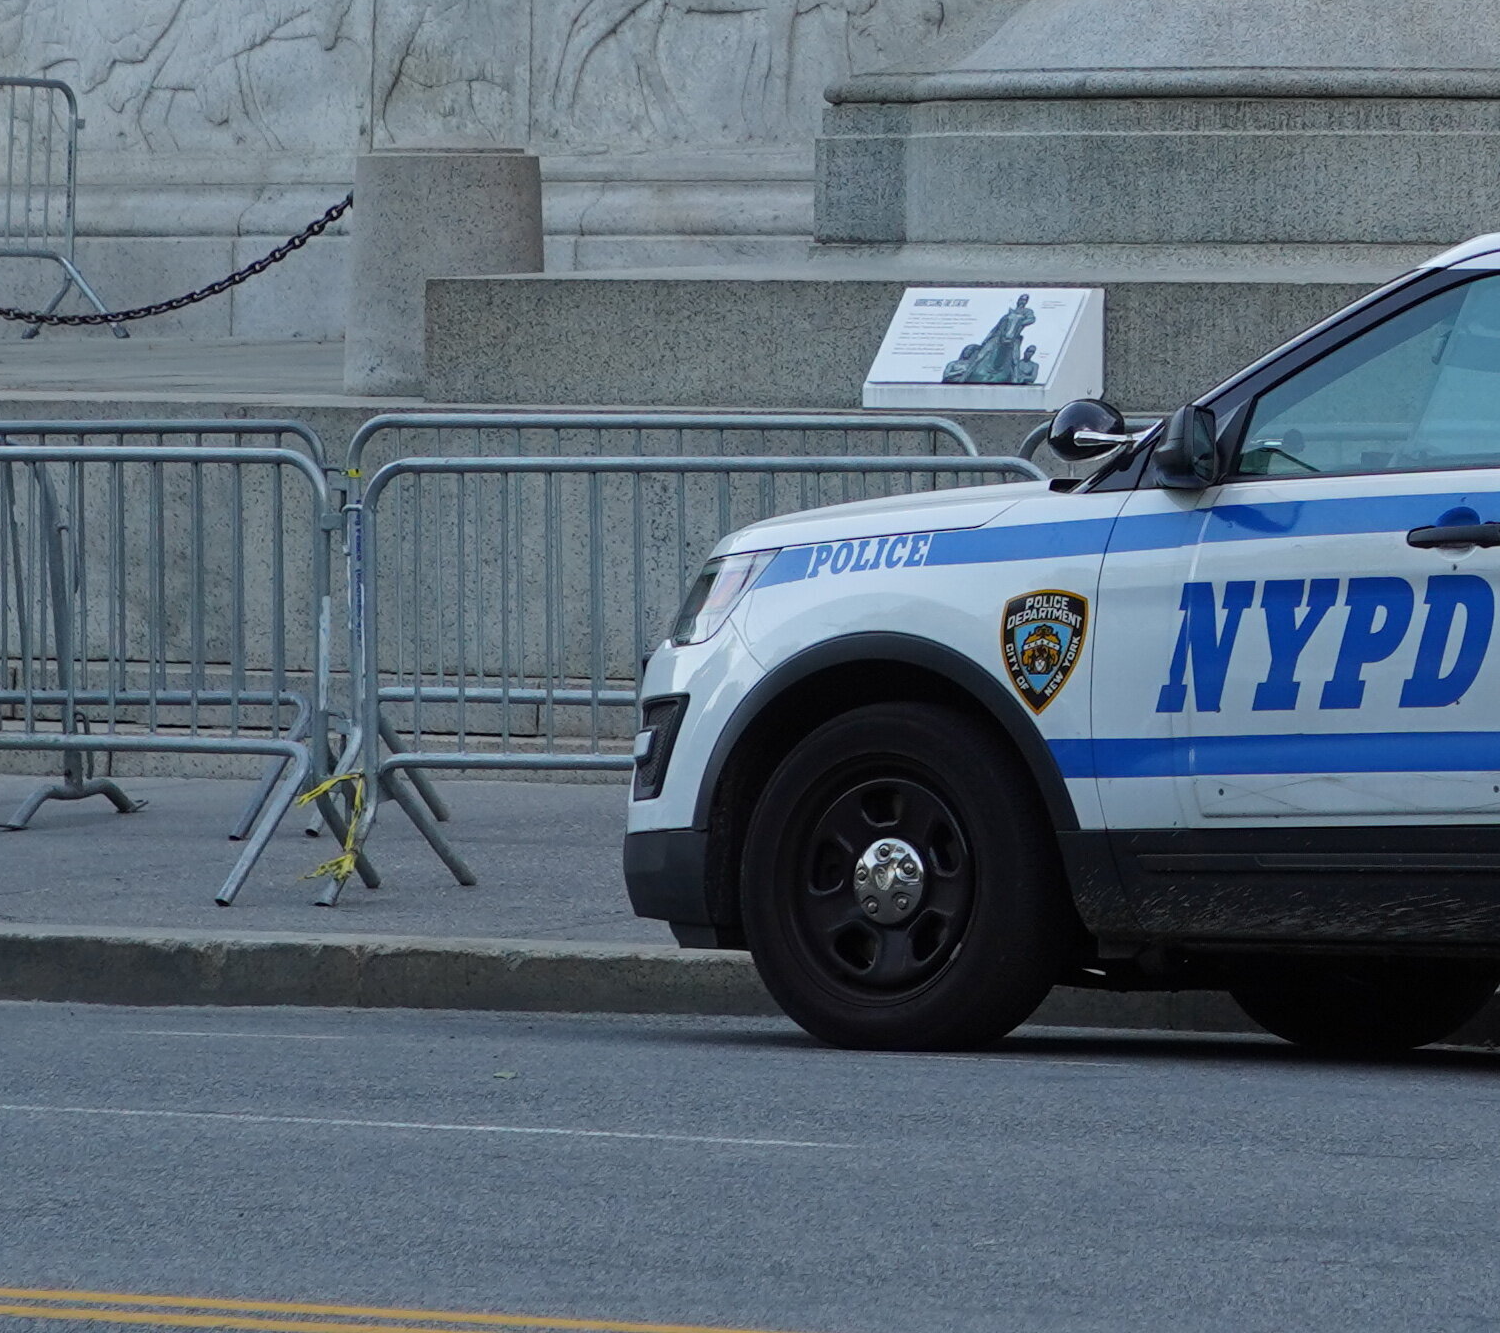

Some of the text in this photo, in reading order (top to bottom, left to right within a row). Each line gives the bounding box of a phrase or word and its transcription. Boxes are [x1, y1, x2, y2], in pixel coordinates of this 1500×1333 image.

[807, 534, 932, 579] POLICE
[1006, 608, 1083, 630] DEPARTMENT
[1025, 595, 1070, 610] POLICE
[1044, 635, 1081, 697] NEW YORK
[1155, 574, 1495, 713] NYPD
[1005, 643, 1030, 691] CITY OF
